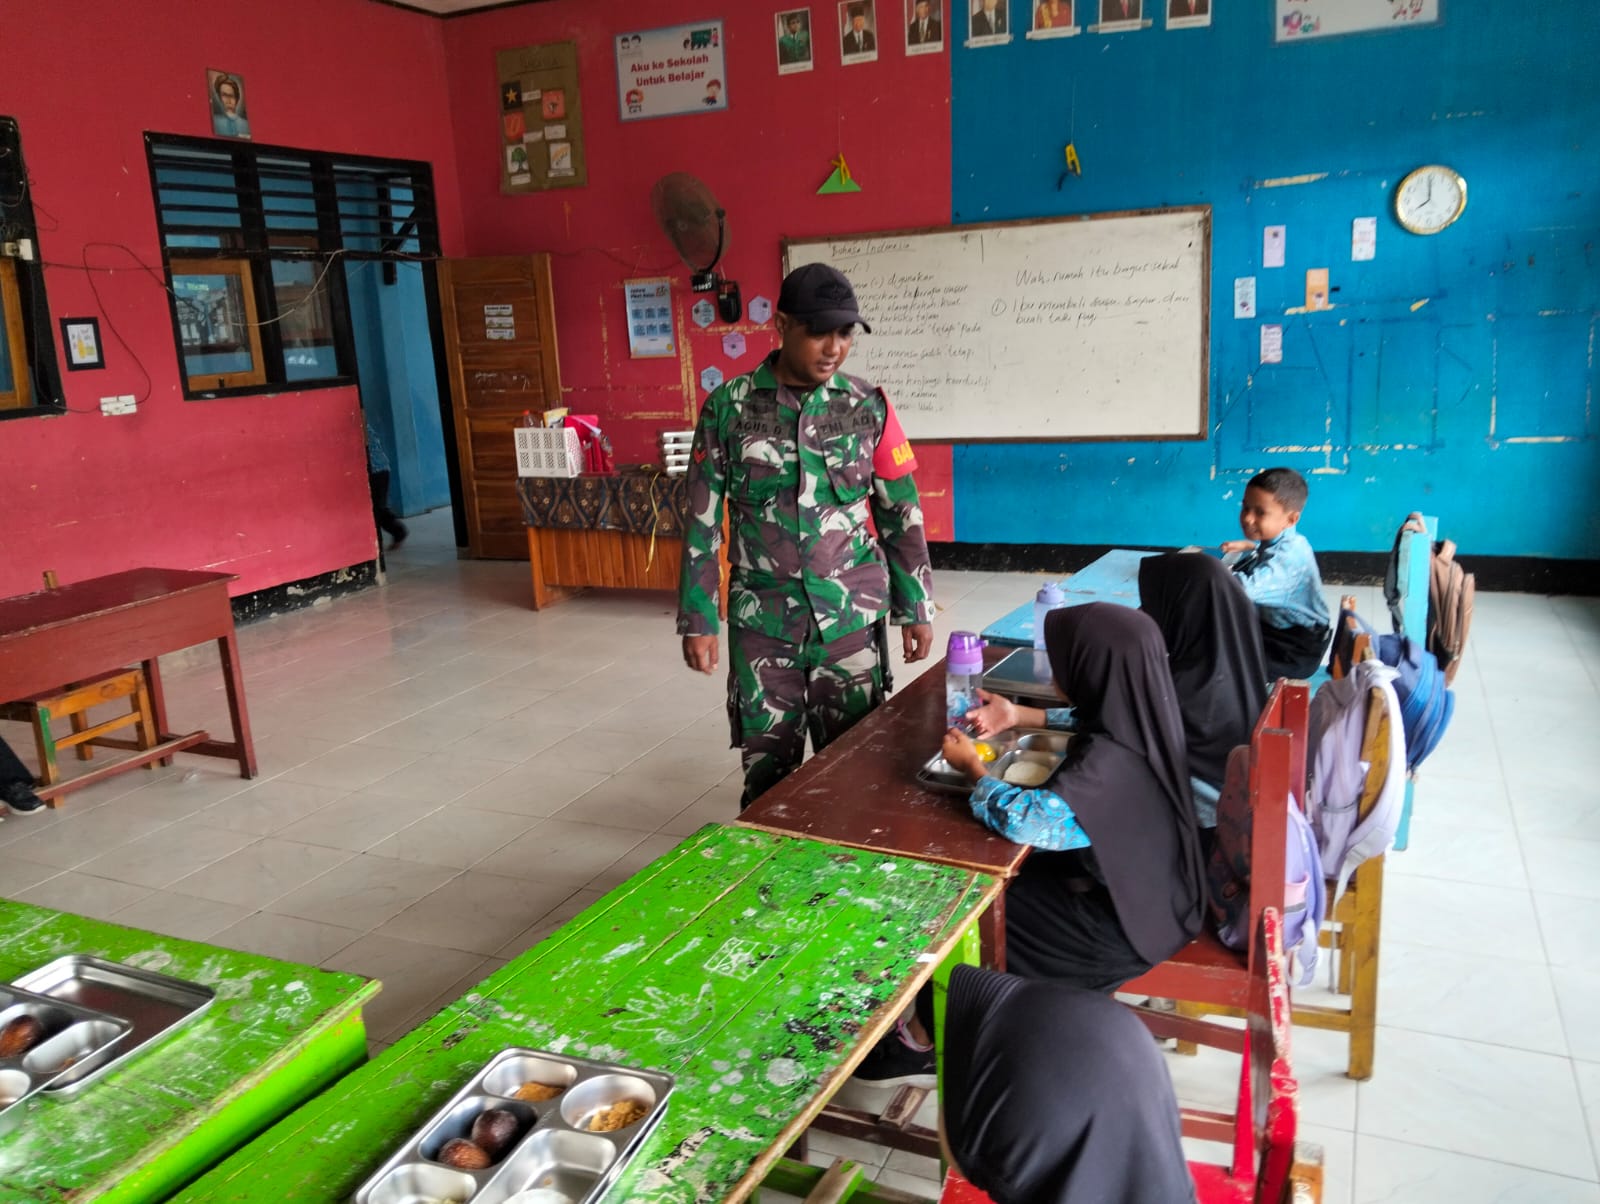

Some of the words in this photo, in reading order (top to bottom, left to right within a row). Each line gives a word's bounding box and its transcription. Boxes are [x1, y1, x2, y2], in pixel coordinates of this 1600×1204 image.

[631, 63, 649, 73] Aku
[652, 61, 664, 70] ke
[667, 54, 709, 68] Sekolah
[636, 75, 666, 87] Untuk
[668, 70, 705, 82] Belajar
[832, 245, 861, 257] Bahasa
[735, 421, 768, 434] AGUS
[820, 421, 844, 435] TNI
